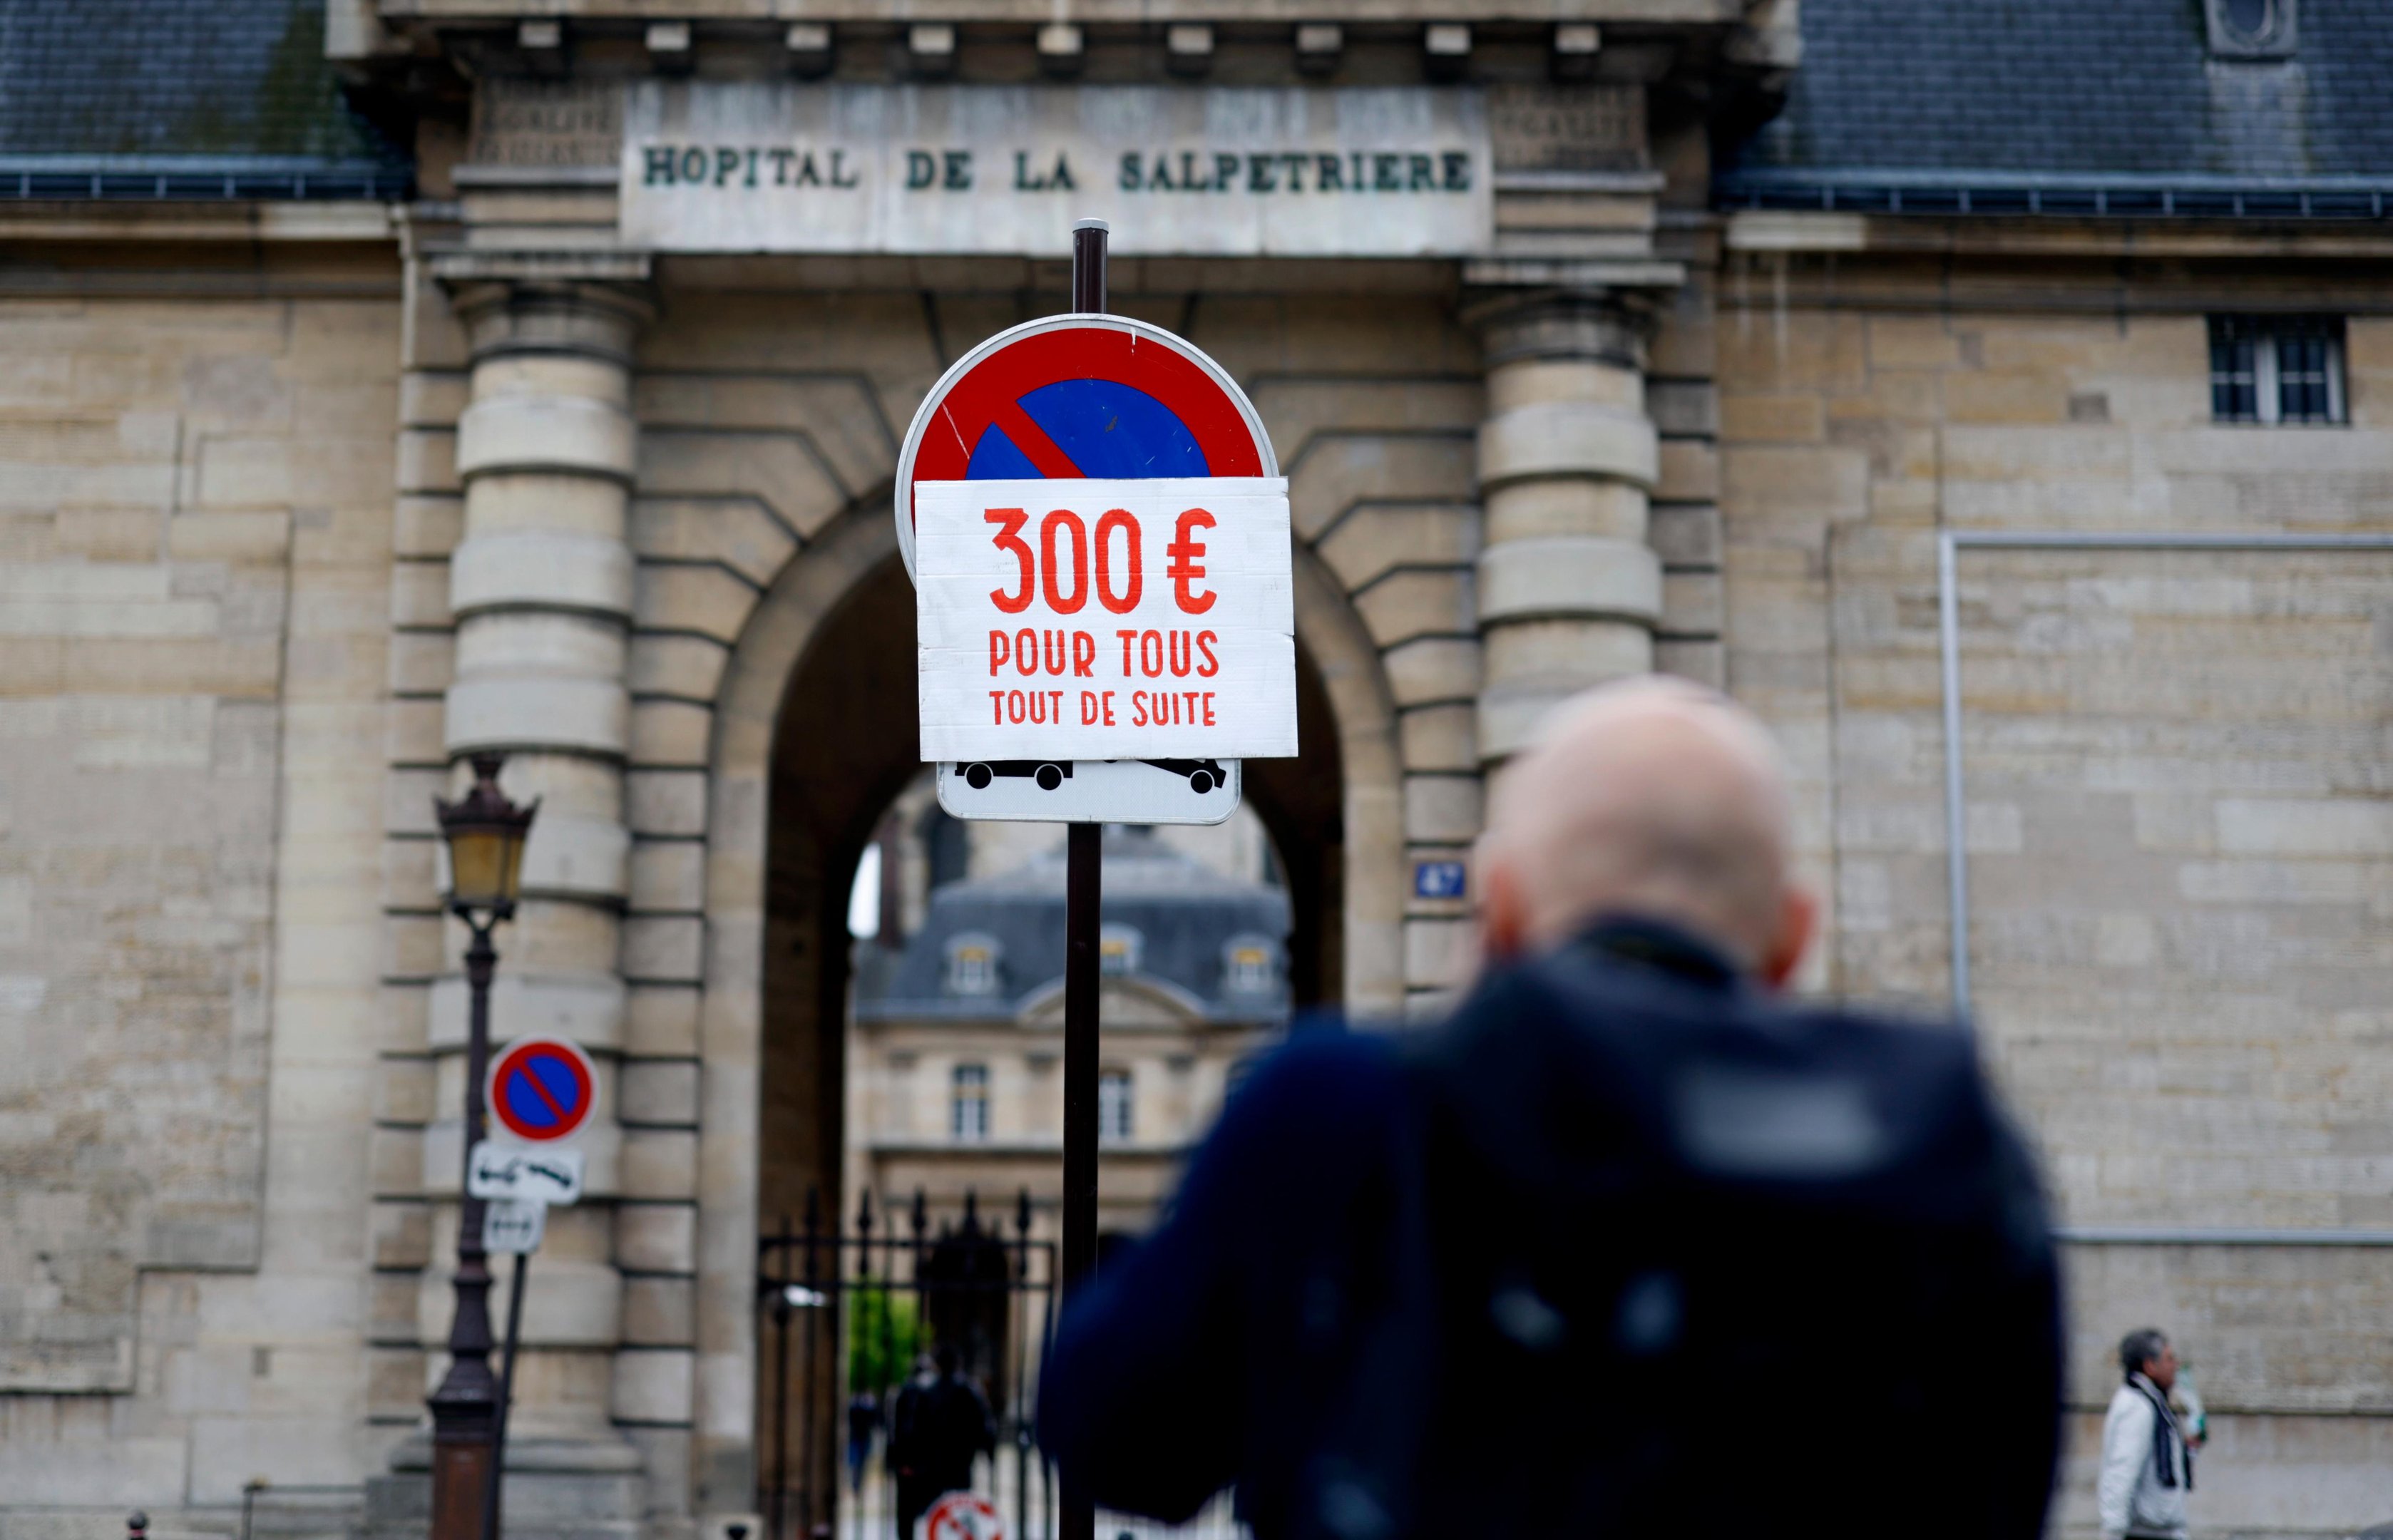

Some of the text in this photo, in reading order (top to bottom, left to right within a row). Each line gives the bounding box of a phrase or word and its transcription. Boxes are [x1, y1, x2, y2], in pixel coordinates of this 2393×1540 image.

[643, 145, 1472, 192] HOPITAL DE LA SALPETRIERE
[984, 508, 1217, 615] 300 €
[989, 627, 1219, 678] POUR TOUS
[989, 690, 1216, 727] TOUT DE SUITE
